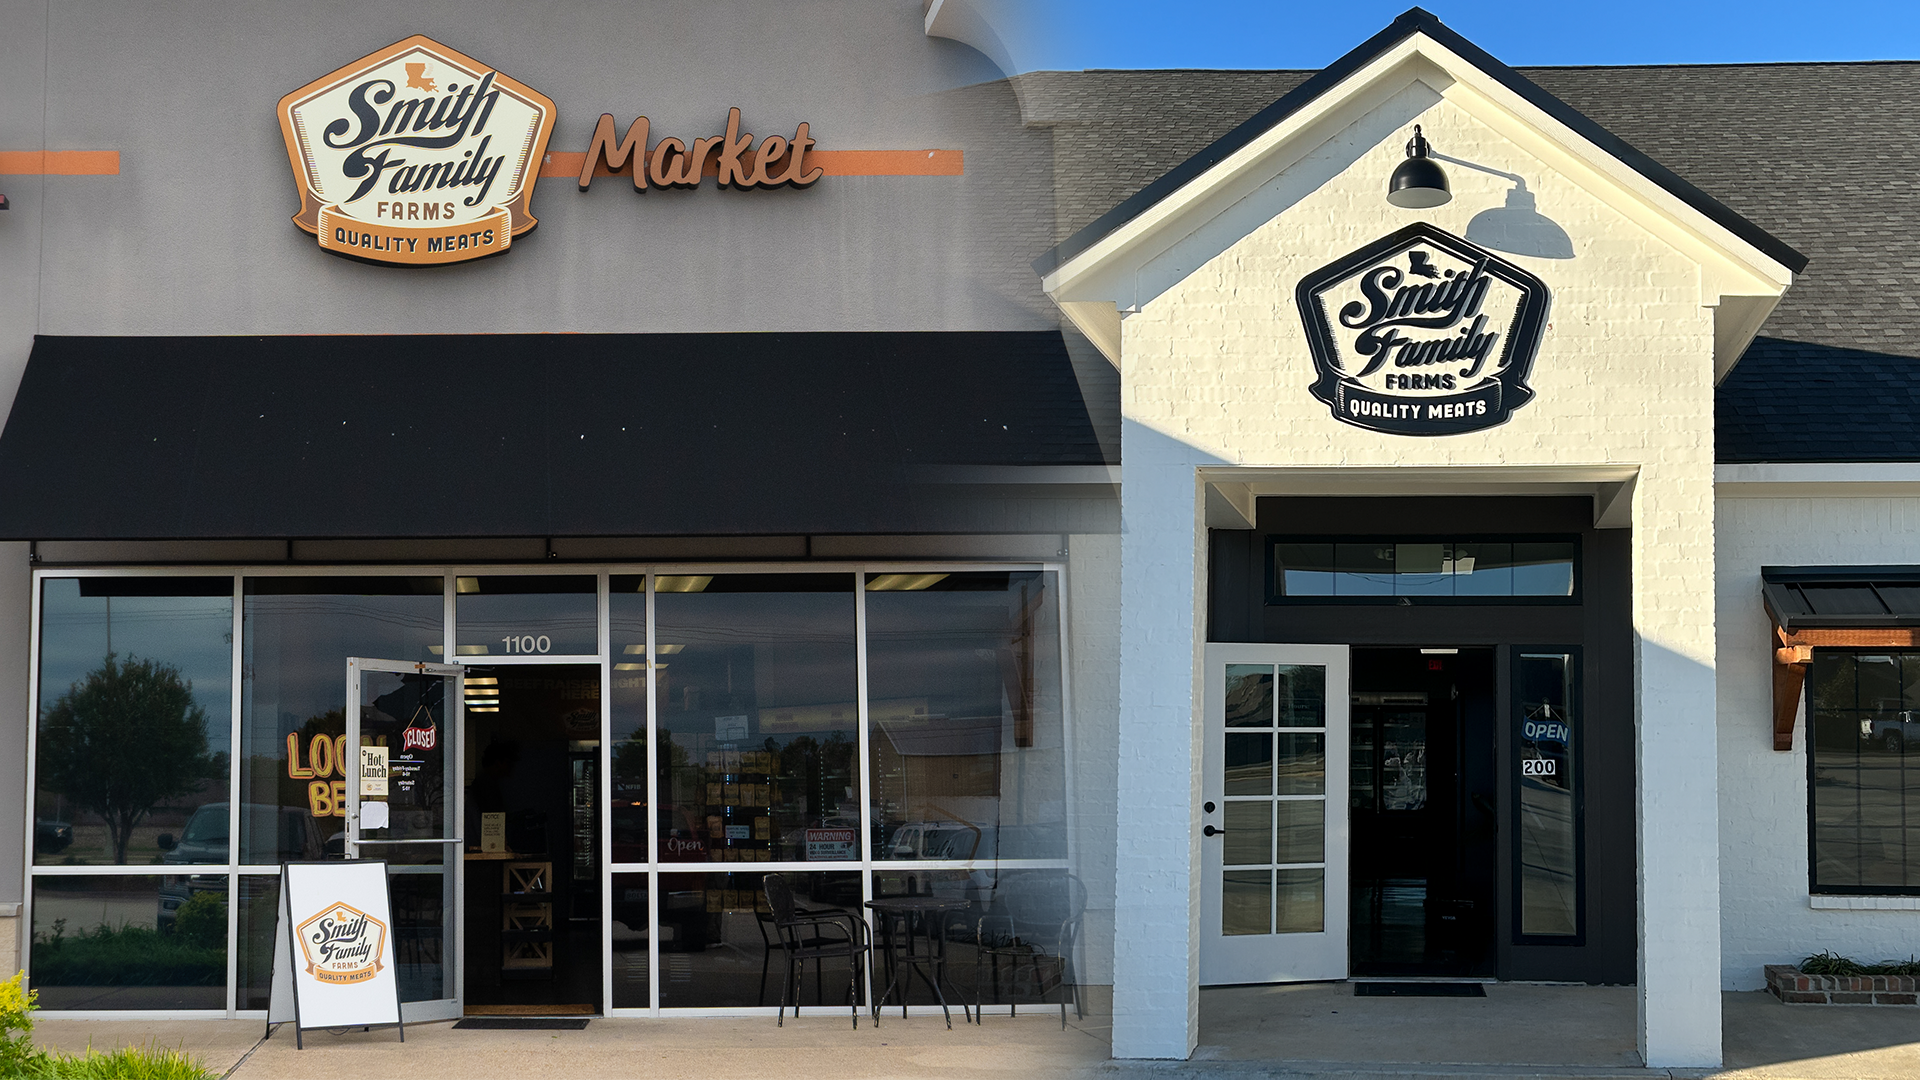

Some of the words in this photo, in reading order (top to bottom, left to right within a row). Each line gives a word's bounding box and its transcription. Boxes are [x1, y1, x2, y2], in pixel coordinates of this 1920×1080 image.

[323, 71, 500, 148] Smith
[578, 107, 825, 194] Market
[342, 135, 507, 207] Family
[377, 202, 456, 221] FARMS
[335, 228, 418, 253] QUALITY
[427, 229, 495, 253] MEATS
[1339, 257, 1493, 329] Smith
[1354, 314, 1500, 378] Family
[1386, 374, 1456, 390] FARMS
[1350, 399, 1421, 419] QUALITY
[1428, 400, 1487, 419] MEATS
[501, 635, 551, 653] 1100
[407, 728, 435, 748] CLOSED
[1524, 722, 1569, 742] OPEN
[367, 752, 381, 766] Hot
[1524, 761, 1554, 774] 200
[362, 765, 387, 778] Lunch
[810, 832, 851, 841] WARNING
[667, 837, 704, 857] Open
[312, 913, 368, 944] Smith
[319, 937, 372, 964] Family
[319, 972, 347, 981] QUALITY
[350, 970, 372, 981] MEATS
[332, 961, 359, 970] FARMS
